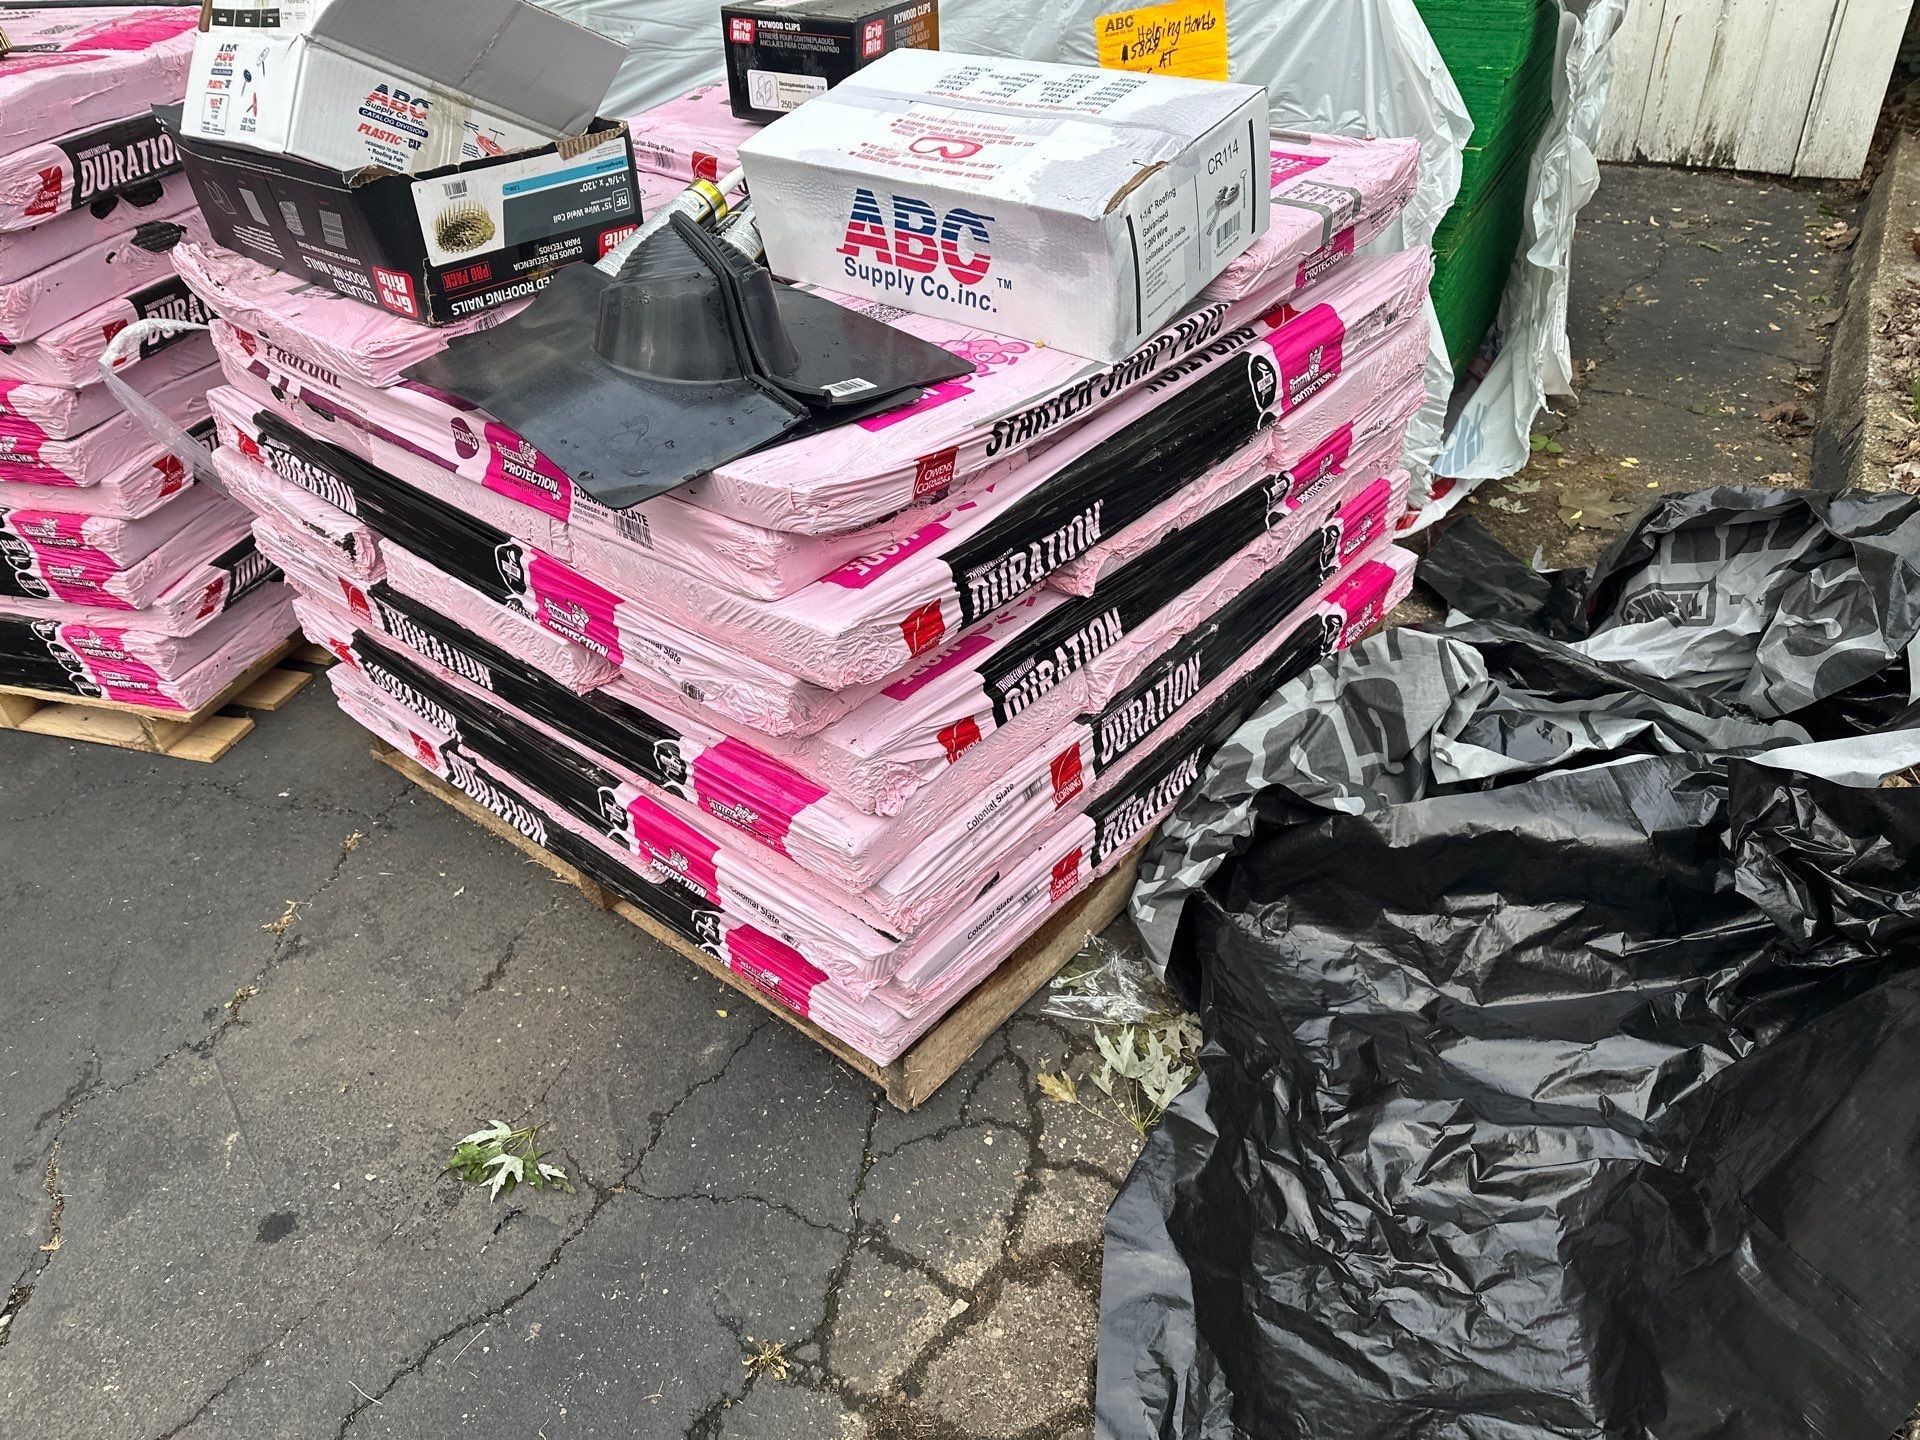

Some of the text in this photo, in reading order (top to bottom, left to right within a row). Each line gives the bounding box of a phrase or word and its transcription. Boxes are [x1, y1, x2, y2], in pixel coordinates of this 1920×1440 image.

[894, 2, 931, 24] PLYWOOD CLIPS
[1104, 14, 1135, 32] ABC
[732, 20, 801, 31] Grip PLYWOOD CLIPS
[732, 30, 751, 41] Rite
[866, 22, 882, 40] Grip
[1137, 18, 1181, 46] Helping
[780, 33, 794, 41] POUR
[866, 38, 881, 54] Rite
[362, 84, 434, 120] ABC
[364, 100, 395, 116] Supply
[396, 112, 408, 122] Co.
[780, 100, 792, 108] 250
[362, 110, 426, 136] CATALOG DIVISION
[372, 148, 404, 164] Roofing Felt
[648, 140, 675, 153] Strip Plus
[1206, 138, 1240, 176] CR114
[374, 156, 404, 170] Housewrap
[604, 176, 626, 190] 1-1/4"
[615, 194, 628, 207] RF
[1154, 188, 1176, 210] Roofing
[553, 212, 568, 223] Coil
[568, 208, 584, 220] Weld
[584, 206, 600, 217] Wire
[1142, 208, 1168, 238] Galvanized
[1156, 226, 1168, 240] Wire
[563, 237, 581, 250] PARA
[836, 188, 996, 286] ABC
[1146, 226, 1186, 264] collated coil nails
[513, 245, 583, 271] CLAVOS EN SECUENCIA
[302, 255, 371, 288] ROOFING NAILS
[378, 271, 408, 290] Rite
[444, 262, 490, 289] PRO PACK
[844, 256, 915, 296] Supply
[335, 278, 378, 304] COLLATED
[484, 279, 540, 307] ROOFING
[996, 277, 1012, 291] TM
[382, 290, 414, 314] Grip
[452, 292, 484, 316] NAILS
[503, 459, 558, 492] PROTECTION
[924, 462, 952, 480] OWENS
[663, 646, 682, 664] Slate
[1101, 652, 1201, 766] DURATION
[1056, 779, 1082, 803] CORNING
[450, 761, 548, 848] DURATION
[966, 782, 1015, 832] Colonial Slate
[1100, 744, 1205, 862] DURATION
[760, 906, 780, 925] Slate
[967, 894, 1014, 940] Colonial Slate
